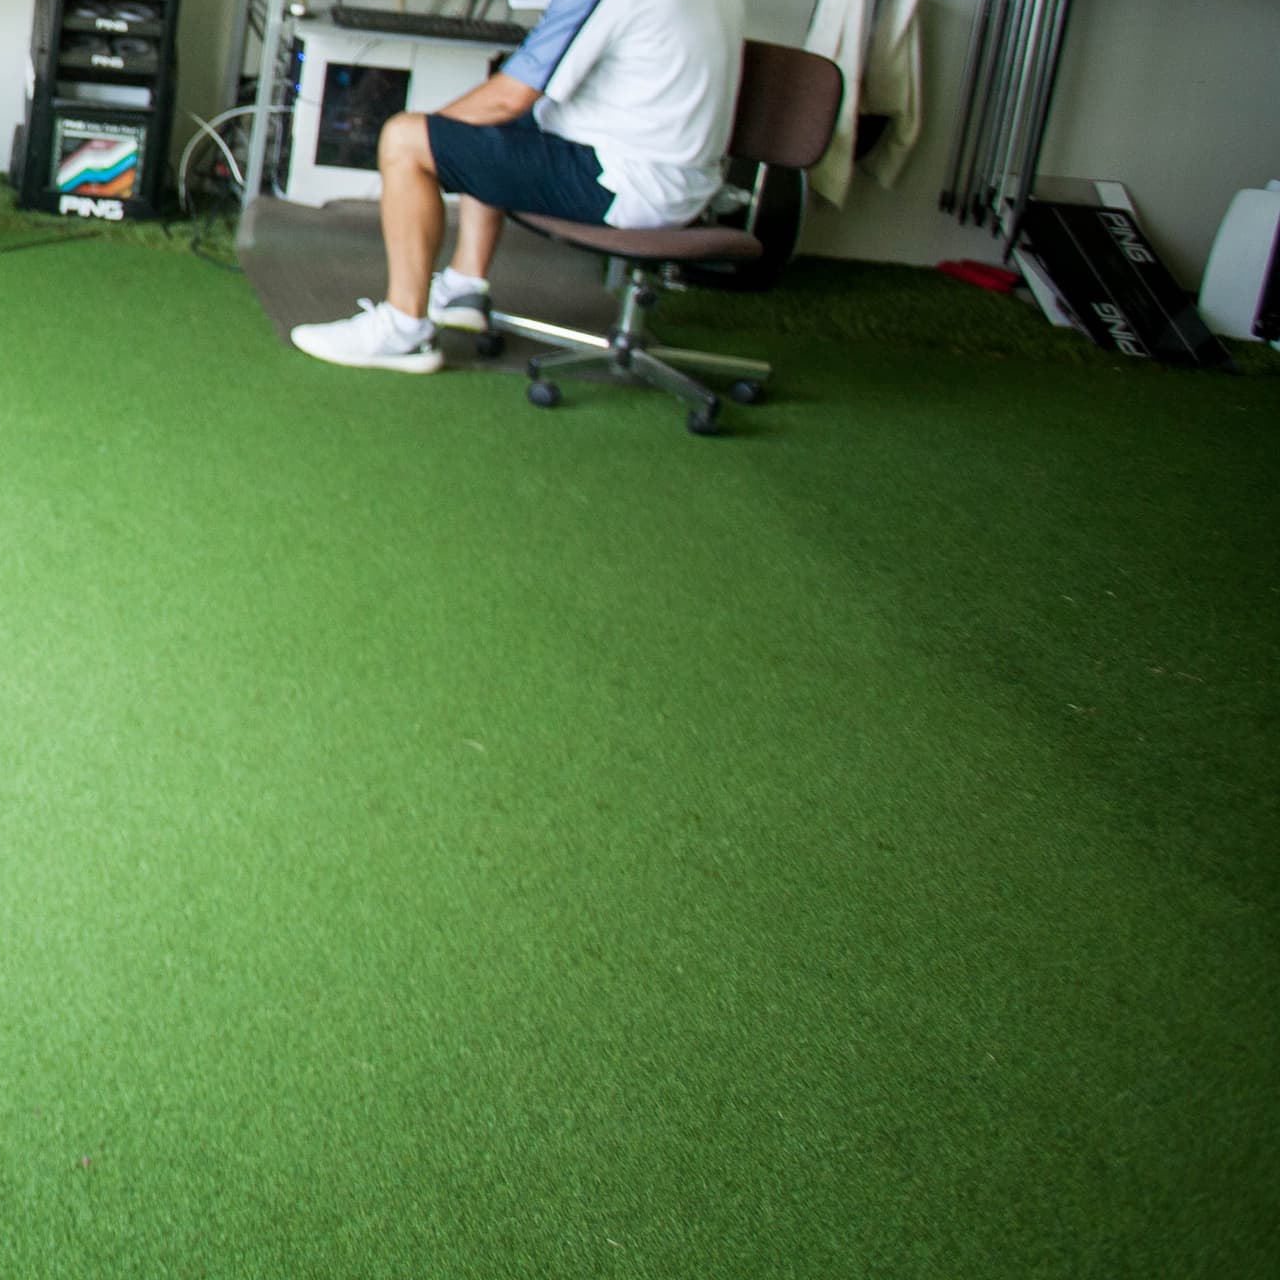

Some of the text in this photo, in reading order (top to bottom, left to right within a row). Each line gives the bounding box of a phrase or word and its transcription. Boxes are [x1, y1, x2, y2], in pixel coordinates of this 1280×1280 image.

[96, 18, 128, 32] PING
[91, 54, 124, 69] PING
[59, 194, 124, 220] PING
[1096, 211, 1155, 263] PING
[1091, 302, 1148, 358] PING
